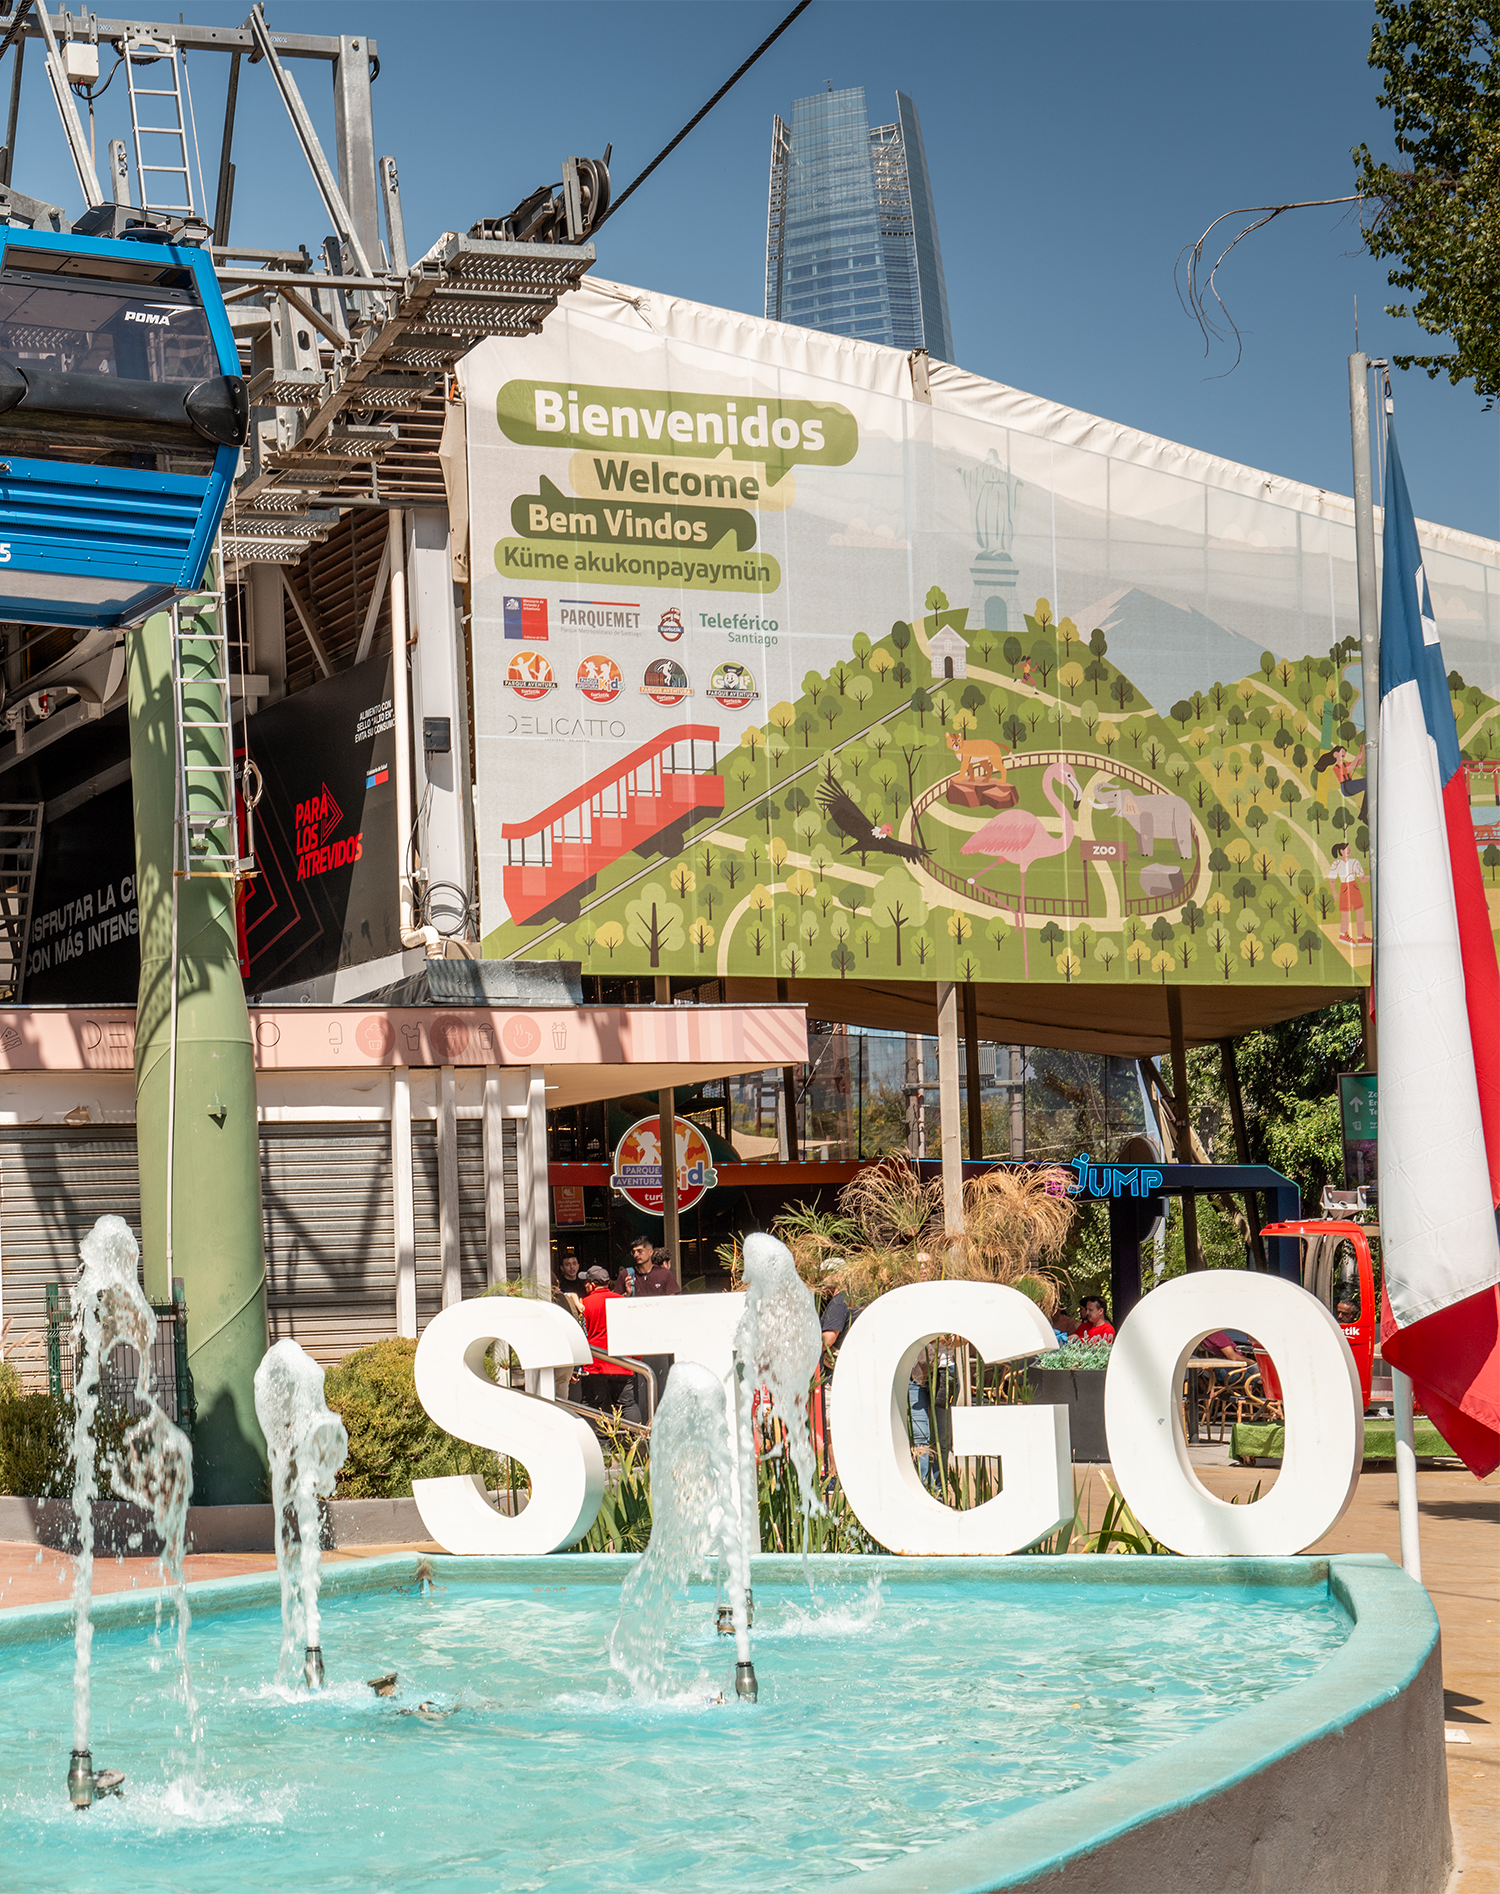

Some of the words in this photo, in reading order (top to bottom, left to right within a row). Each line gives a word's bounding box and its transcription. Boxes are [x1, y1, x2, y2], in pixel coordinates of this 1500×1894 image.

[124, 310, 171, 326] POMA
[534, 389, 826, 450] Bienvenidos
[594, 458, 760, 500] Welcome
[529, 503, 598, 536] Bem
[603, 508, 708, 542] Vindos
[504, 545, 569, 571] Küme
[573, 551, 771, 583] akukonpayaymün
[561, 608, 640, 628] PARQUEMET
[699, 613, 779, 631] Teleférico
[728, 632, 778, 648] Santiago
[357, 718, 372, 732] SELLO
[367, 727, 374, 738] SU
[507, 714, 626, 738] DELICATTO
[295, 793, 328, 829] PARA
[296, 822, 319, 856] LOS
[1092, 845, 1117, 857] ZOO
[296, 832, 363, 882] ATREVIDOS
[97, 884, 116, 914] LA
[54, 929, 84, 966] MÁS
[616, 1178, 661, 1186] AVENTURA
[626, 1167, 660, 1175] PARQUE
[412, 1268, 1364, 1558] STGO
